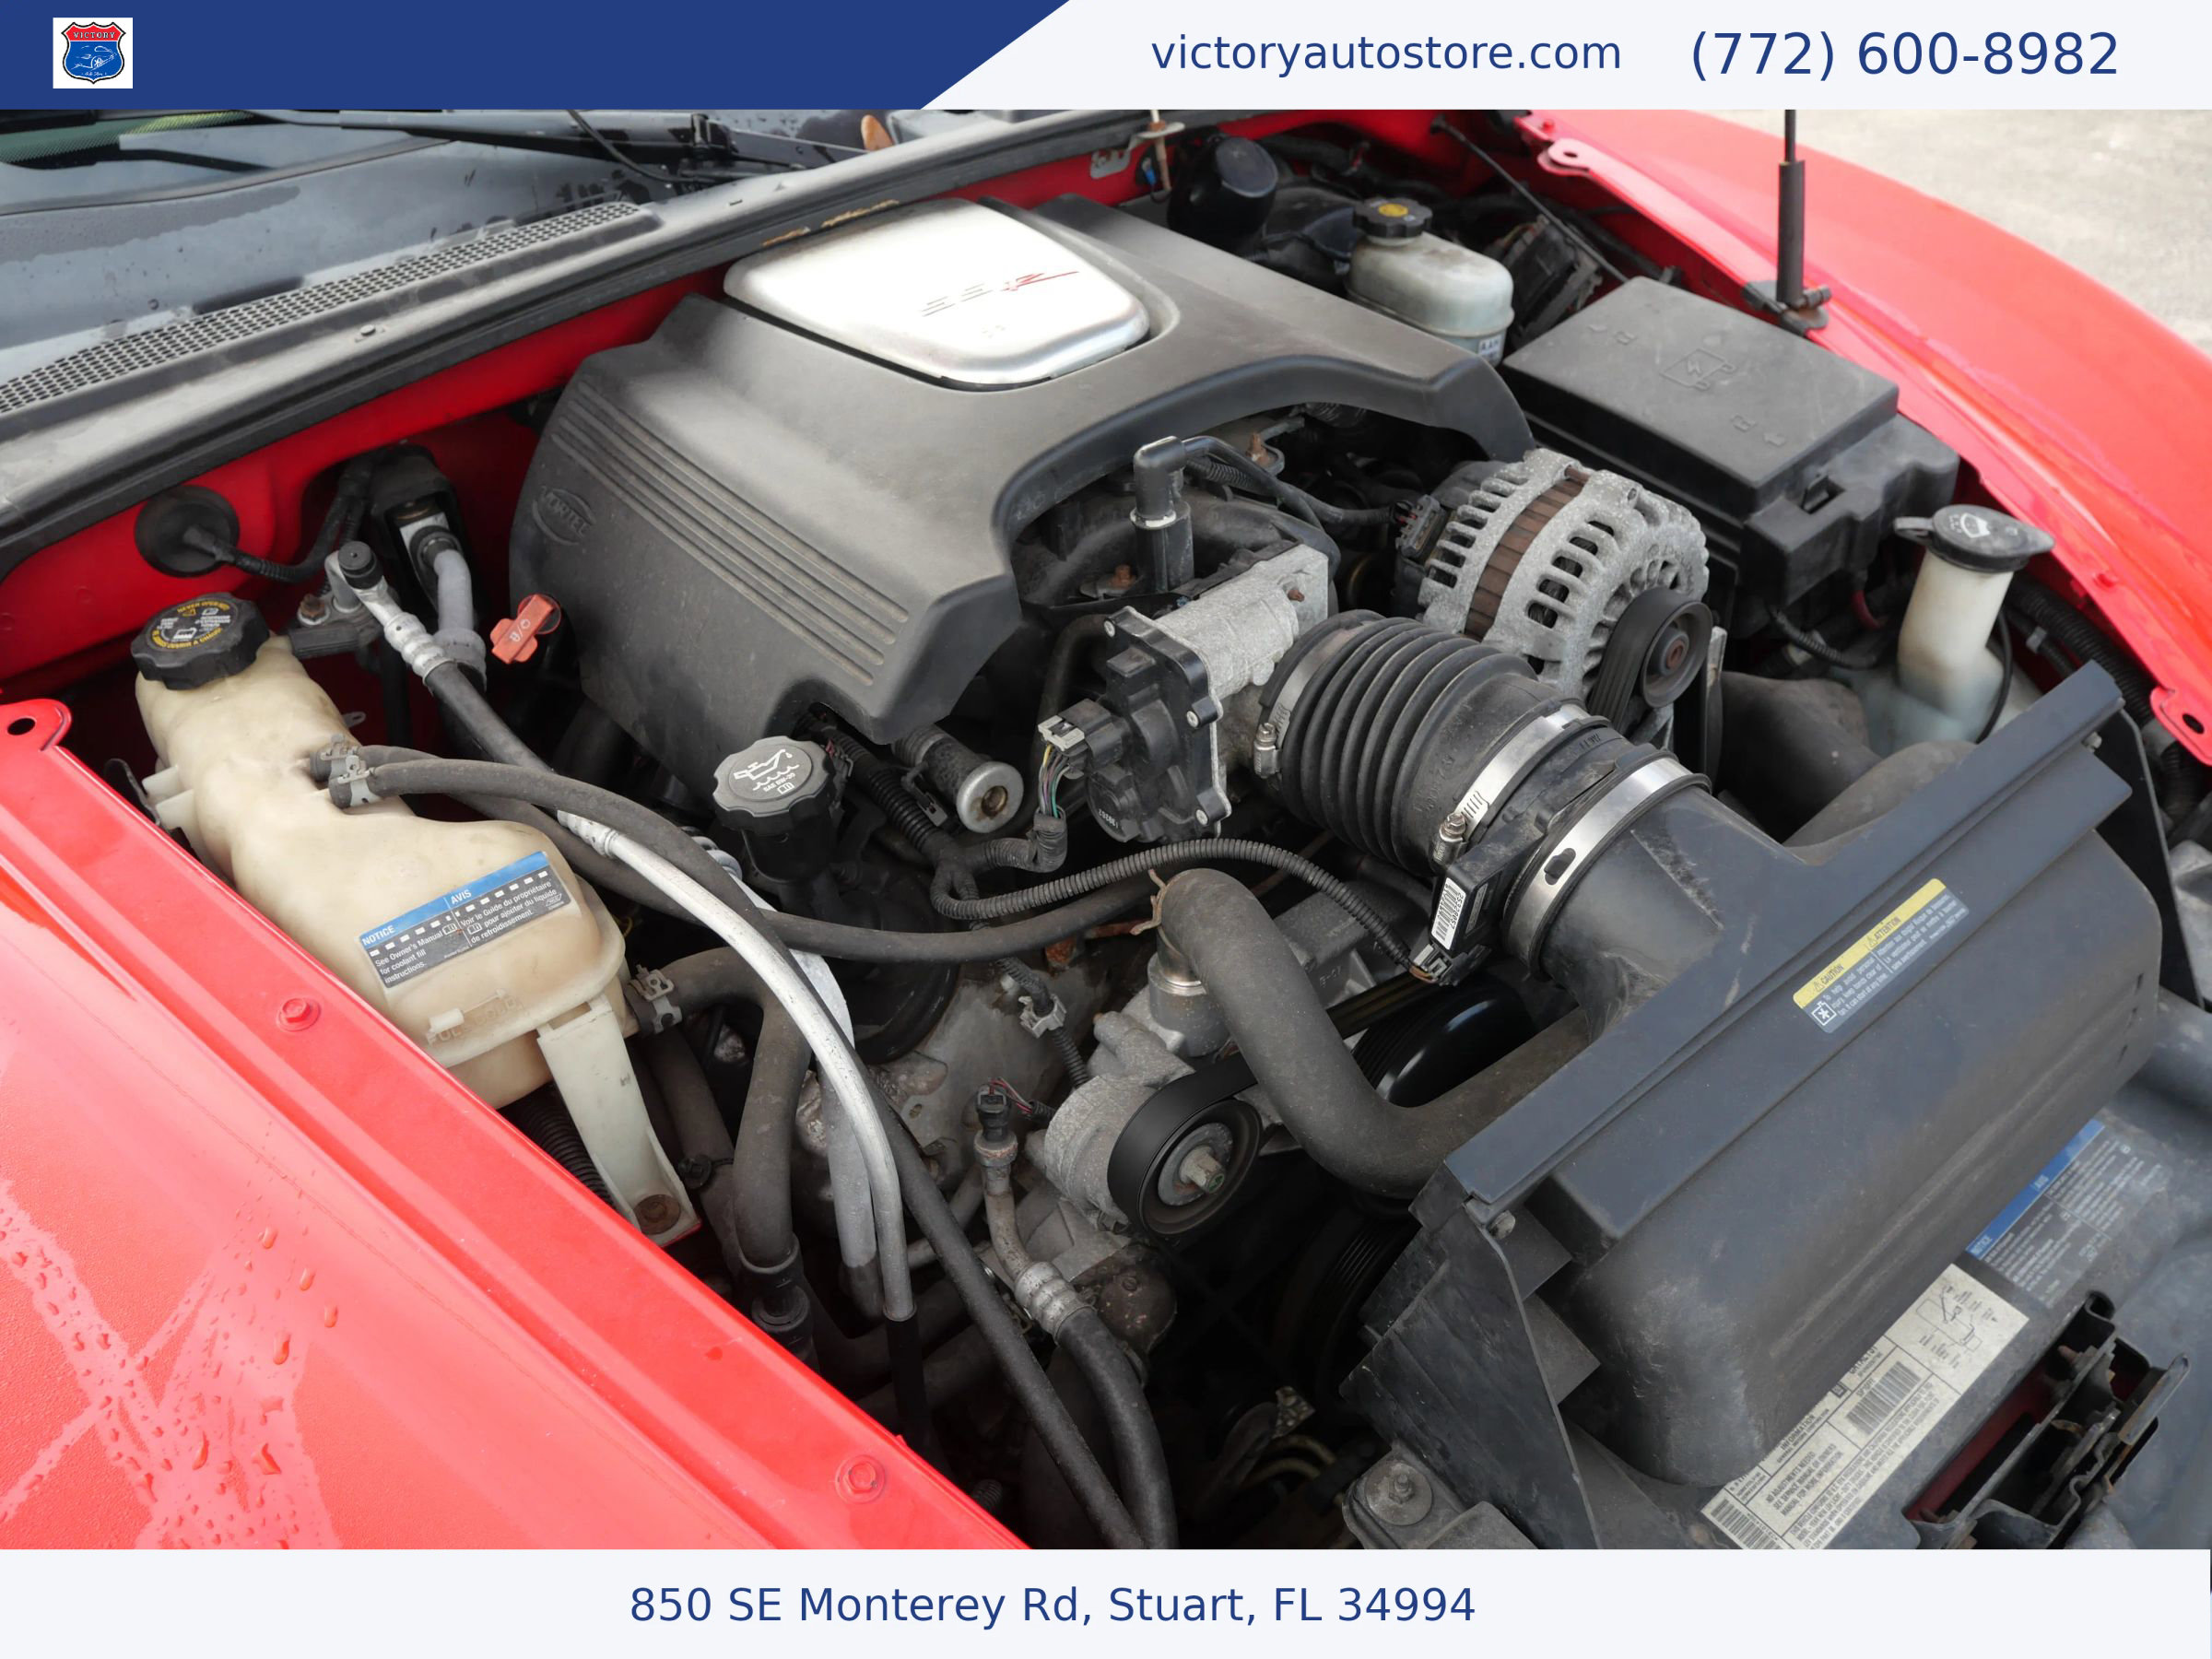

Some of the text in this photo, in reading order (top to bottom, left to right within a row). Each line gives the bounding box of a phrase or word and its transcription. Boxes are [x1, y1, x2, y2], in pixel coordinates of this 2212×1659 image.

[537, 487, 593, 537] VORTEC
[762, 782, 777, 792] SAE
[450, 888, 472, 904] AVIS
[460, 915, 475, 926] Voir
[474, 912, 483, 920] le
[482, 901, 503, 916] Guide
[502, 897, 513, 907] du
[512, 878, 552, 904] propriétaire
[483, 915, 500, 927] pour
[499, 902, 524, 920] ajouter
[524, 898, 534, 907] du
[533, 887, 557, 903] liquide
[361, 924, 394, 946] NOTICE
[470, 909, 533, 943] de refroidissement.
[1873, 915, 1901, 940] ATTENTION
[375, 930, 443, 967] See Owner's Manual
[379, 947, 427, 975] for coolant fill
[383, 959, 428, 984] instructions.
[1818, 962, 1844, 985] CAUTION
[1969, 1234, 1992, 1257] NOTICE
[1779, 1413, 1816, 1451] INFORMATION
[1764, 1493, 1775, 1504] NO
[1771, 1465, 1802, 1498] ADJUSTMENTS
[1781, 1481, 1800, 1501] SERVICE
[1795, 1488, 1807, 1500] FOR
